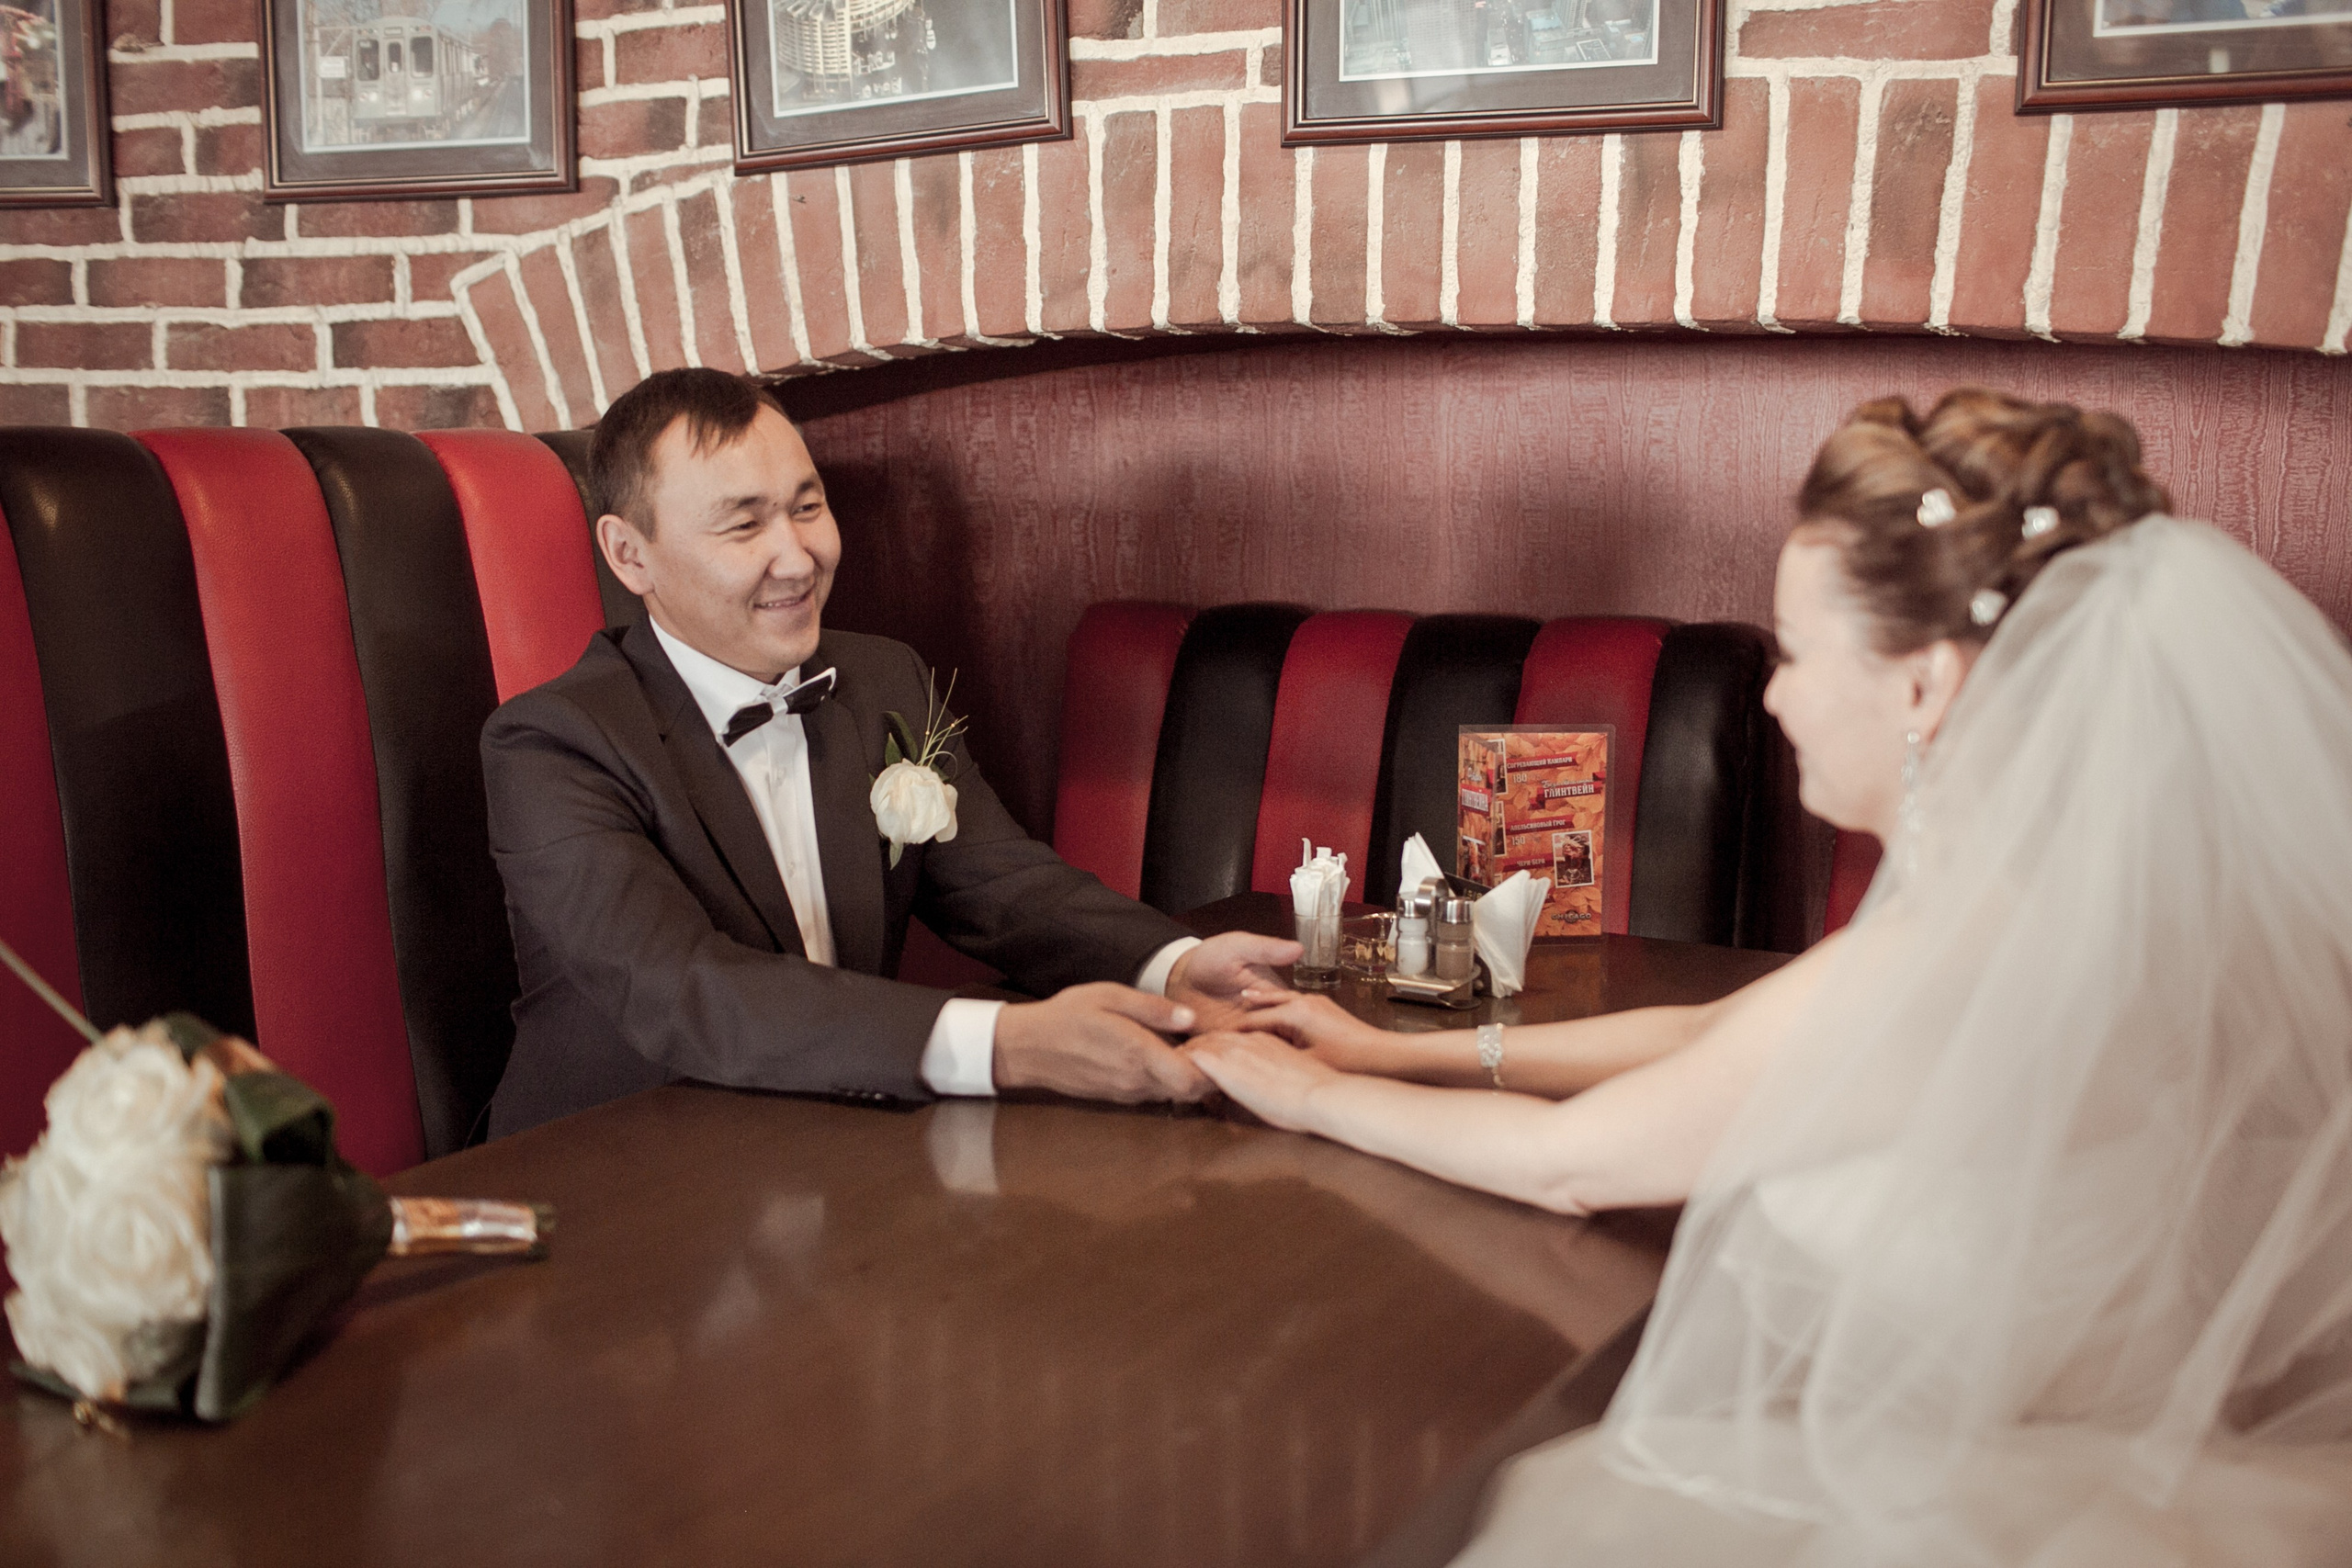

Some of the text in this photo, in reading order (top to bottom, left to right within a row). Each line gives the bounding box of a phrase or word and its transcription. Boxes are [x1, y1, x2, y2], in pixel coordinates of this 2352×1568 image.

[1512, 773, 1528, 784] 180
[1544, 784, 1594, 798] ГЛИНТВЕЙН
[1511, 836, 1526, 846] 150
[1551, 911, 1592, 920] CHICAGO
